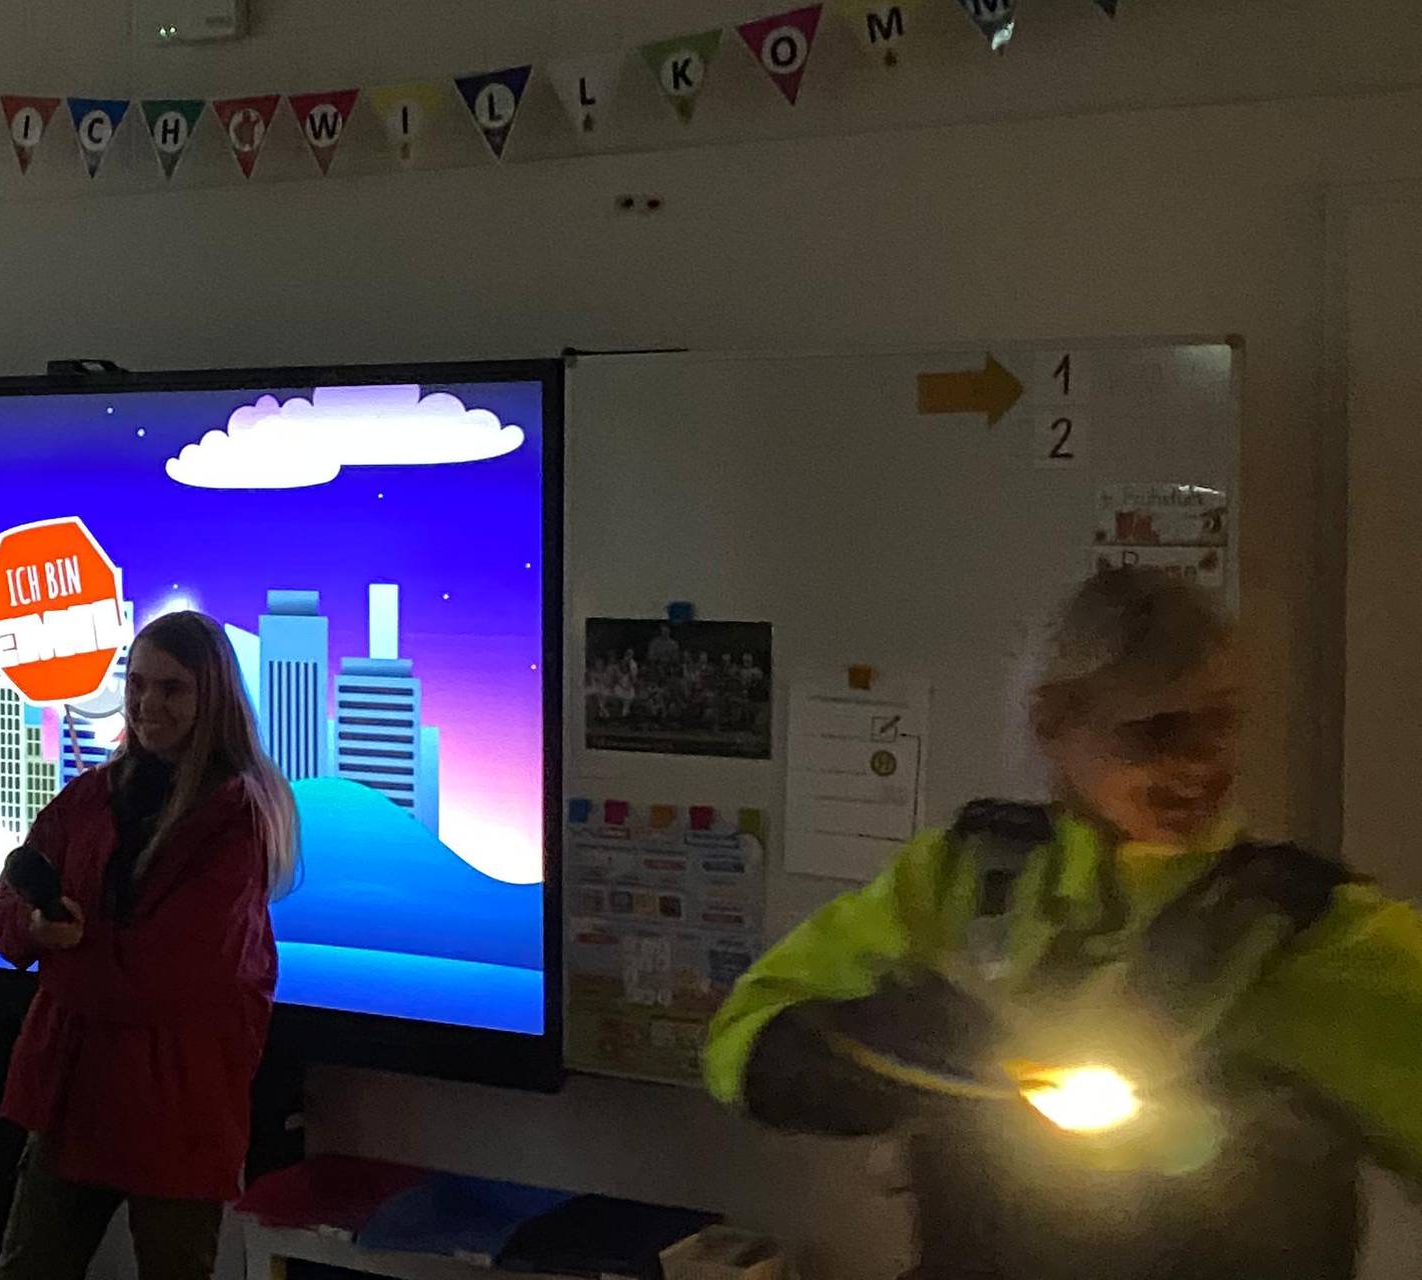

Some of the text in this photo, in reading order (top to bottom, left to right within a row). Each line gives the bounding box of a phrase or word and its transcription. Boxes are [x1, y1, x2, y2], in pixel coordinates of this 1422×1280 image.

[1052, 354, 1071, 395] 1
[1048, 418, 1075, 460] 2
[5, 555, 82, 607] ICH BIN
